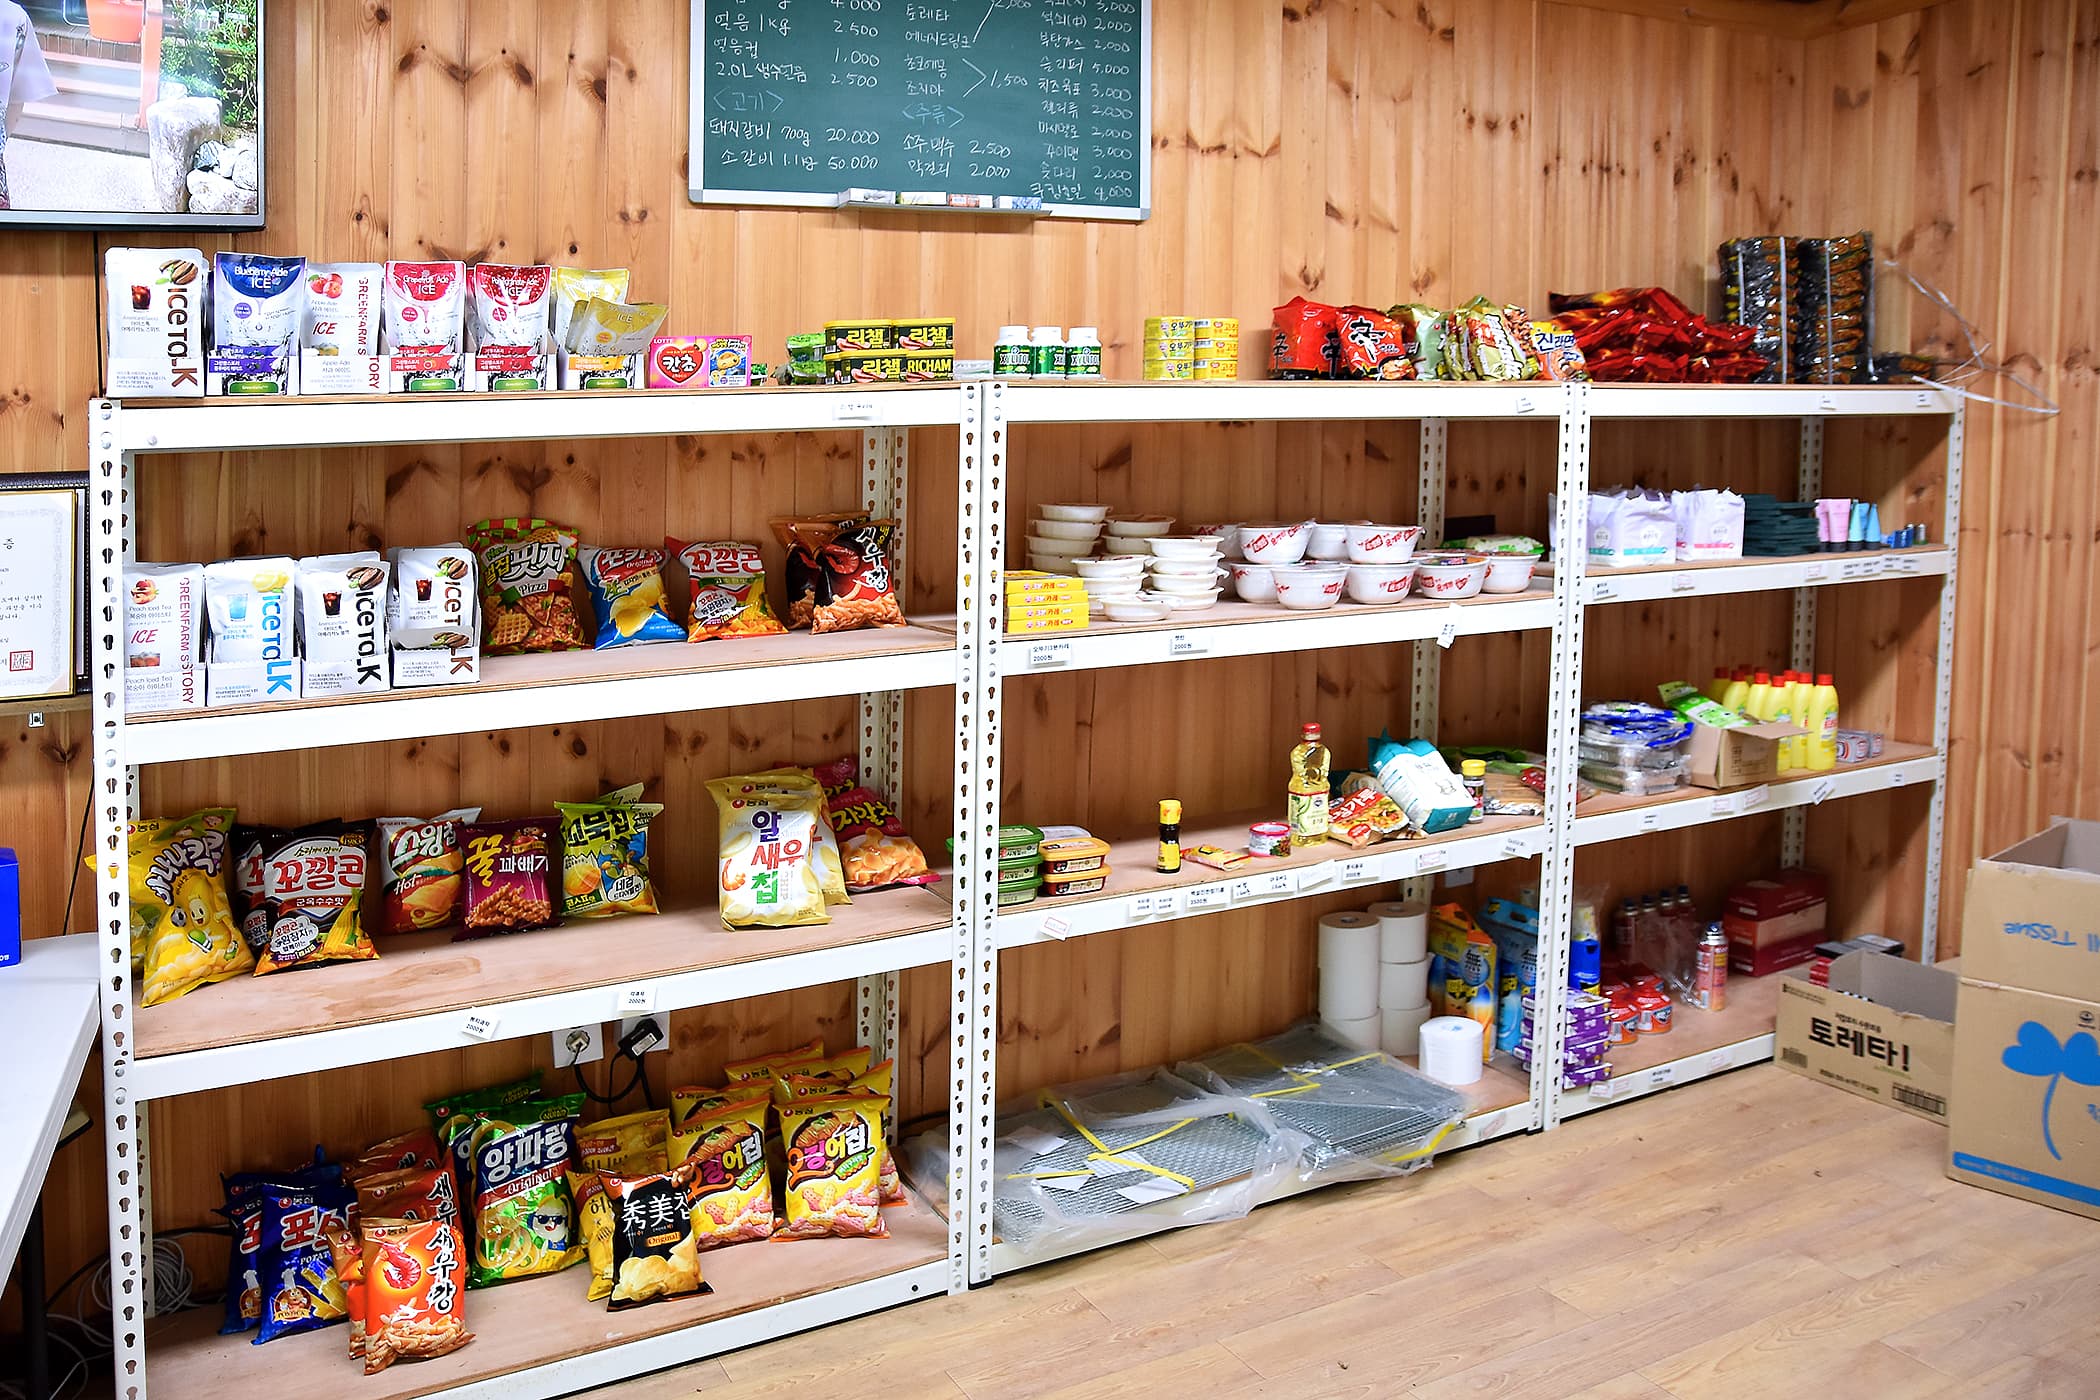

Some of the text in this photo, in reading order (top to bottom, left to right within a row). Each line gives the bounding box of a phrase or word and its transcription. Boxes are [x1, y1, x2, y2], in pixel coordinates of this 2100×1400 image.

[714, 11, 750, 32] 얼음
[905, 3, 950, 22] 토레타
[1093, 17, 1132, 33] 2,000
[713, 37, 759, 60] 얼음컵
[905, 31, 972, 49] 에너지드링크
[1040, 31, 1131, 53] 부탄가스 2,000
[715, 62, 754, 79] 2.0L
[904, 53, 947, 79] 초코에몽
[1040, 55, 1083, 75] 슬리퍼
[905, 80, 945, 97] 조지아
[990, 69, 1028, 89] 1,500
[1090, 83, 1132, 102] 3,000
[1041, 100, 1133, 120] 젤리류 2,000
[709, 117, 771, 141] 돼지갈비
[780, 126, 811, 148] 700g
[1091, 126, 1133, 140] 2,000
[968, 140, 1011, 159] 2,500
[1092, 145, 1133, 160] 3,000
[908, 159, 1011, 178] 막걸리 2,000
[1091, 165, 1133, 181] 2,000
[1030, 182, 1087, 201] 쿠킹호일
[251, 278, 272, 289] ICE
[418, 286, 436, 295] ICE
[617, 313, 633, 322] ICE
[312, 321, 338, 335] ICE
[847, 327, 884, 349] 리챔
[911, 327, 947, 348] 리챔
[1535, 332, 1575, 352] 진라면
[662, 353, 697, 373] 칸쵸
[862, 358, 902, 379] 리챔
[907, 358, 952, 373] RICHAM
[486, 545, 507, 560] New
[500, 542, 570, 582] 핏자
[685, 547, 767, 574] 꼬깔콘
[855, 526, 889, 593] 새우깡
[519, 582, 548, 595] Pizza
[130, 629, 159, 644] ICE
[830, 801, 896, 832] 자갈치
[137, 822, 160, 833] 농심
[751, 811, 783, 843] 알
[466, 834, 504, 888] 꿀
[499, 854, 549, 874] 꽈배기
[751, 839, 805, 871] 새우
[145, 830, 229, 906] 바나나킥
[272, 854, 364, 893] 꼬깔콘
[394, 874, 422, 896] Hot
[750, 871, 778, 905] 칩
[296, 897, 345, 907] 군옥수수맛
[2004, 922, 2078, 946] Tissue
[466, 1023, 486, 1034] 2000원
[1809, 1017, 1910, 1072] 토레타!
[484, 1121, 569, 1184] 양파링
[787, 1124, 867, 1191] 오징어집
[292, 1195, 314, 1206] 농심
[426, 1171, 459, 1227] 새우
[647, 1232, 679, 1246] Original
[425, 1225, 460, 1315] 새우깡
